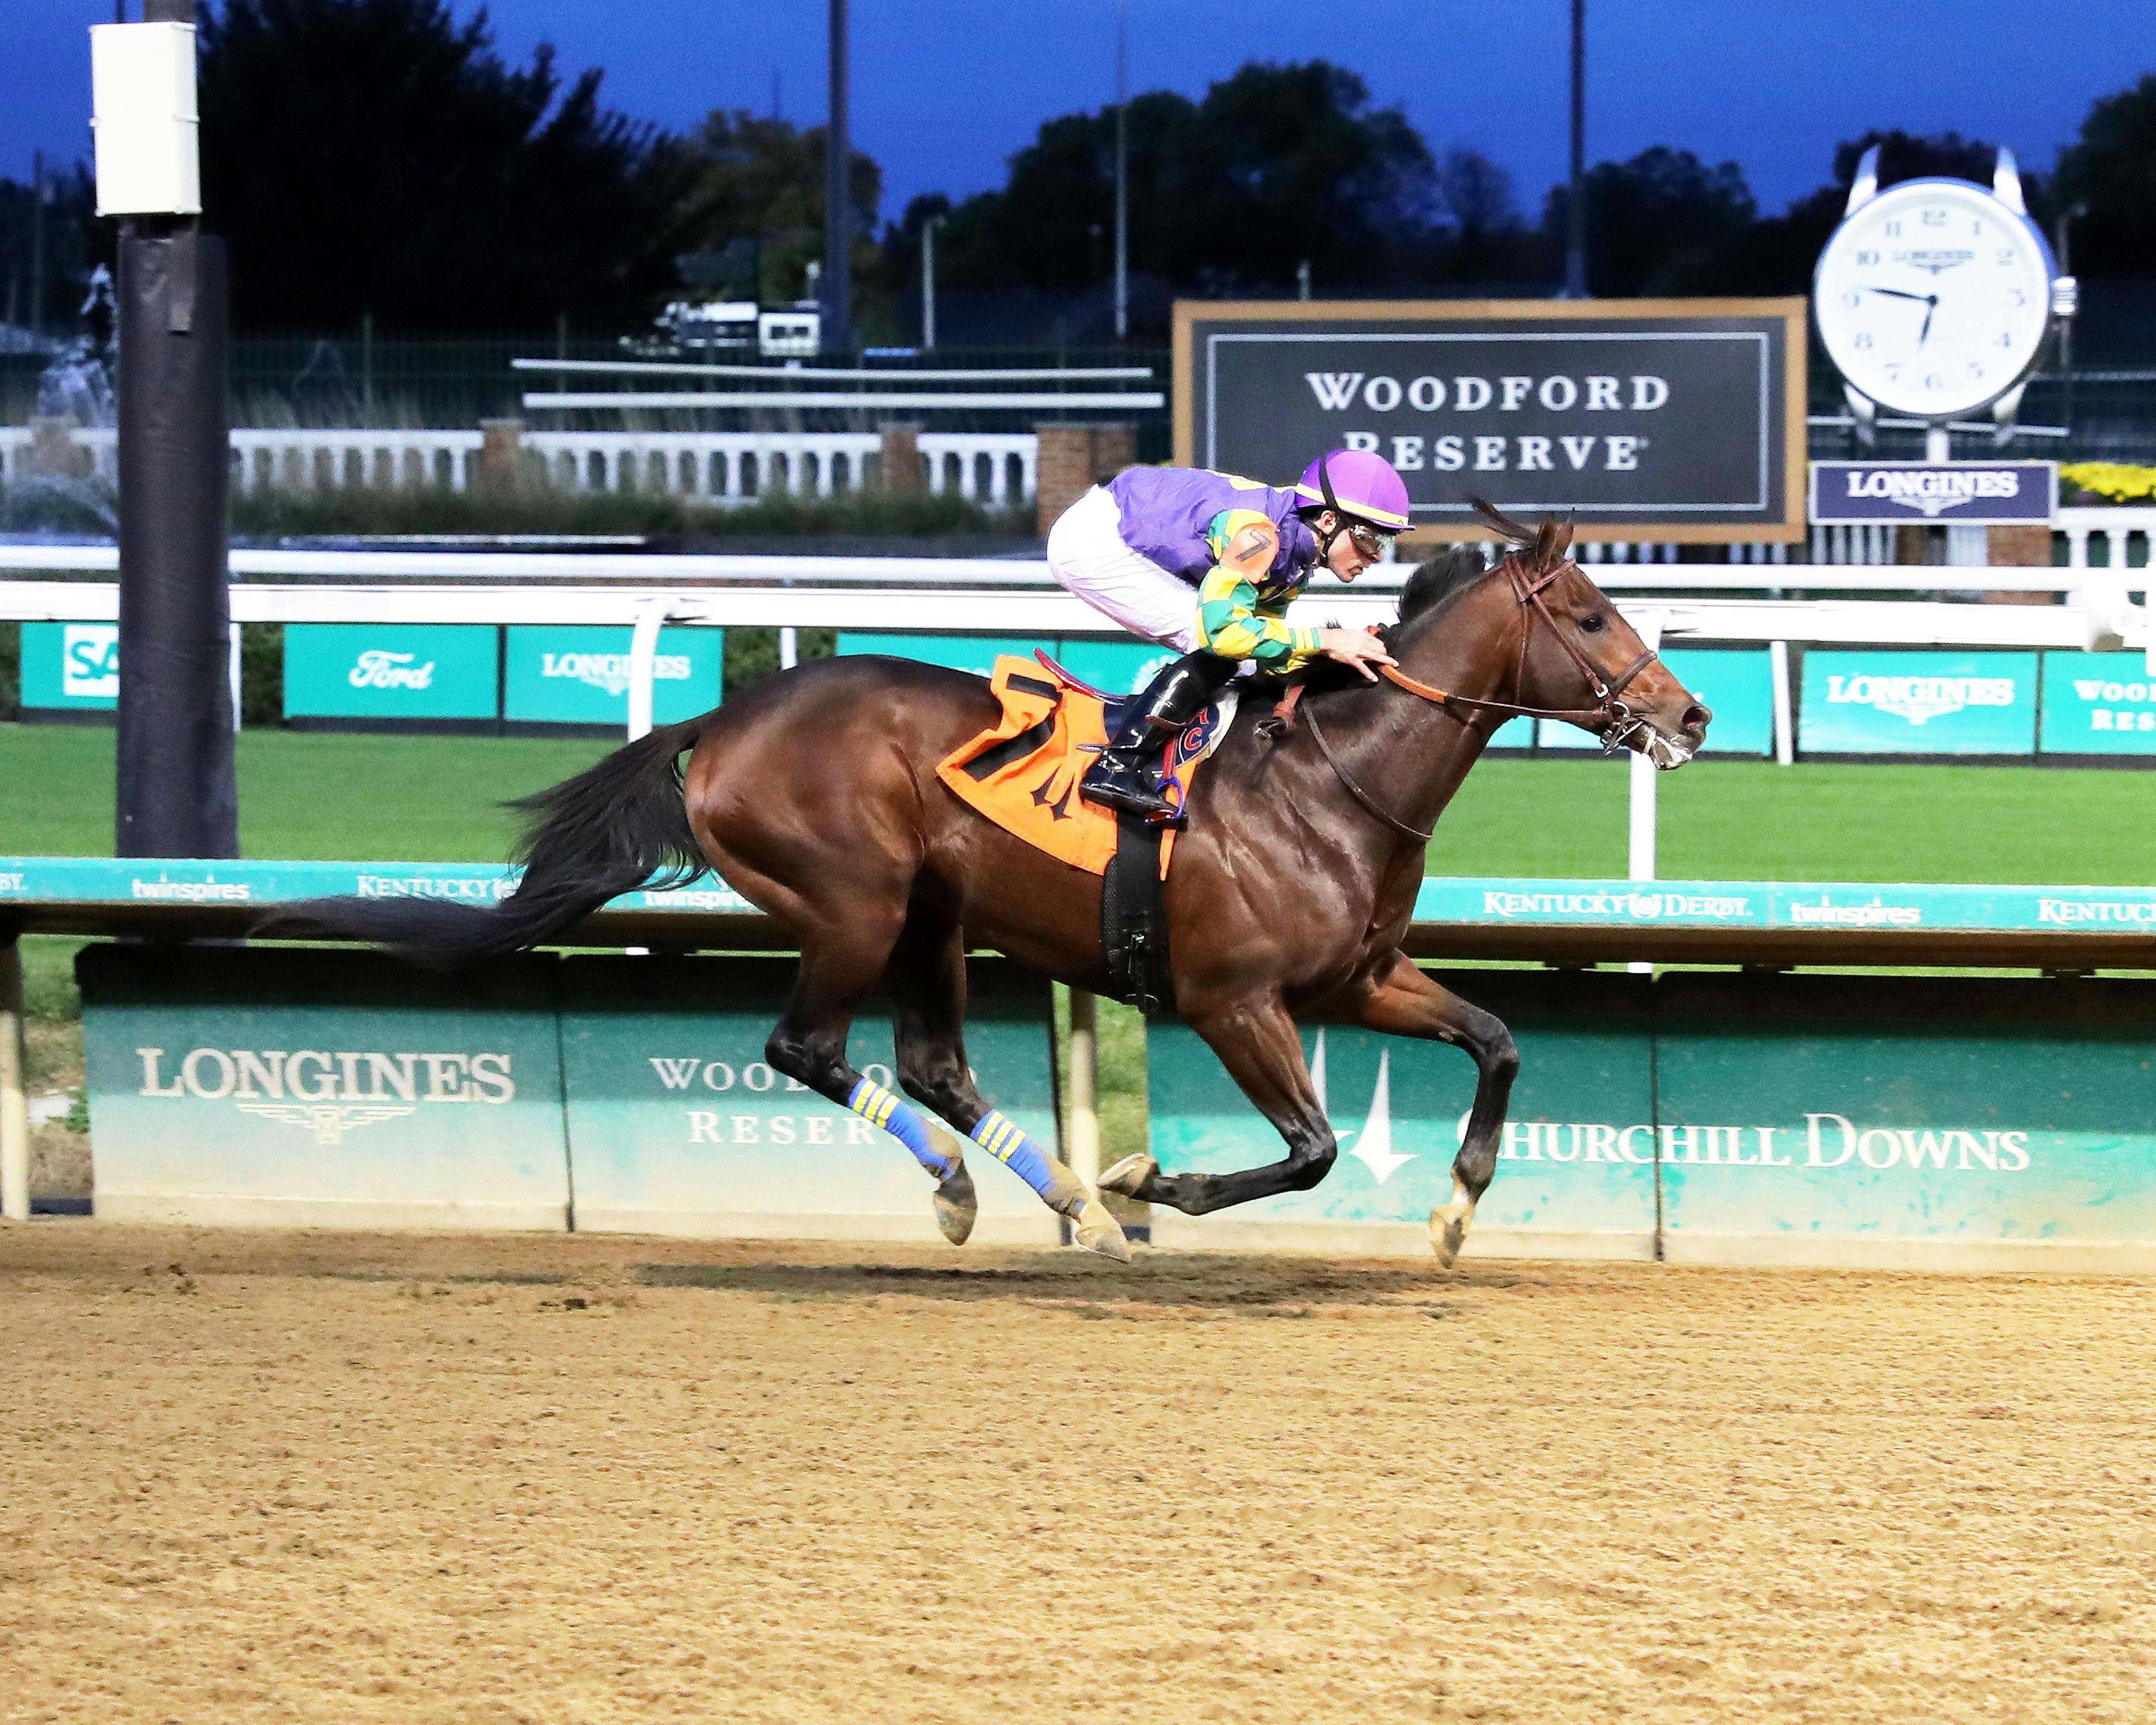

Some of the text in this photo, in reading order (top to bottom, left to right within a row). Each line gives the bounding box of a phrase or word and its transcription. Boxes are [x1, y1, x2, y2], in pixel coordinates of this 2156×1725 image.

[1306, 373, 1669, 411] WOODFORD
[1847, 471, 2019, 498] LONGINES
[1235, 529, 1271, 562] 7
[349, 650, 435, 689] Ford
[542, 653, 691, 680] LONGIES
[1827, 676, 2015, 706] LONGINES
[132, 872, 250, 901] twinspires
[357, 875, 490, 900] KENTUCKY
[1483, 891, 1629, 918] KENTUCKY
[1791, 895, 1921, 925] twinspires
[2037, 899, 2156, 925] KENTUC
[136, 1048, 515, 1104] LONGINES
[686, 1110, 947, 1145] RESER
[1803, 1113, 2030, 1172] DOWNS
